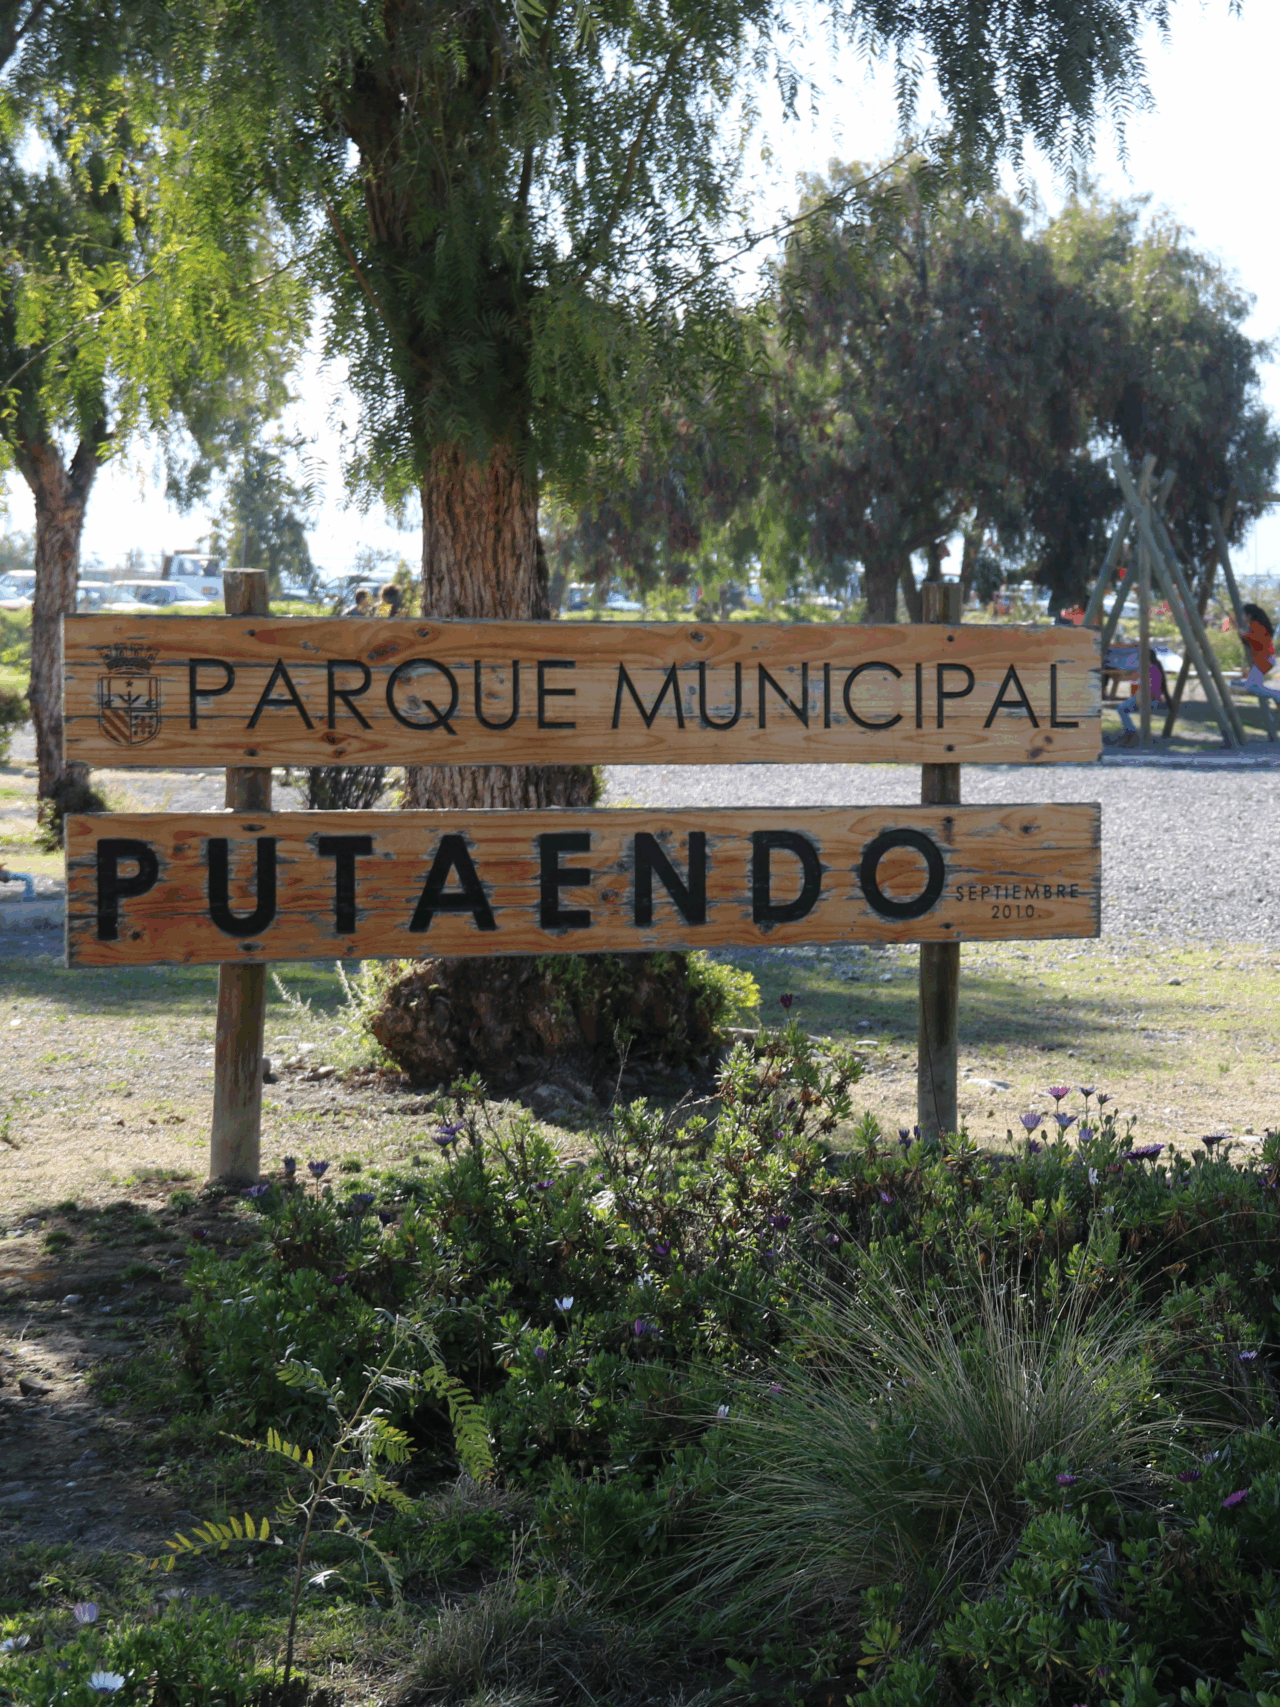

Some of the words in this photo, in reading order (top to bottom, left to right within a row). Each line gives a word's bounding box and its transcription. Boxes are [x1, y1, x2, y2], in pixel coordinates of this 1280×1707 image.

[188, 657, 576, 735] PARQUE
[611, 660, 1080, 730] MUNICIPAL
[96, 828, 946, 941] PUTAENDO
[955, 883, 1080, 902] SEPTIEMBRE
